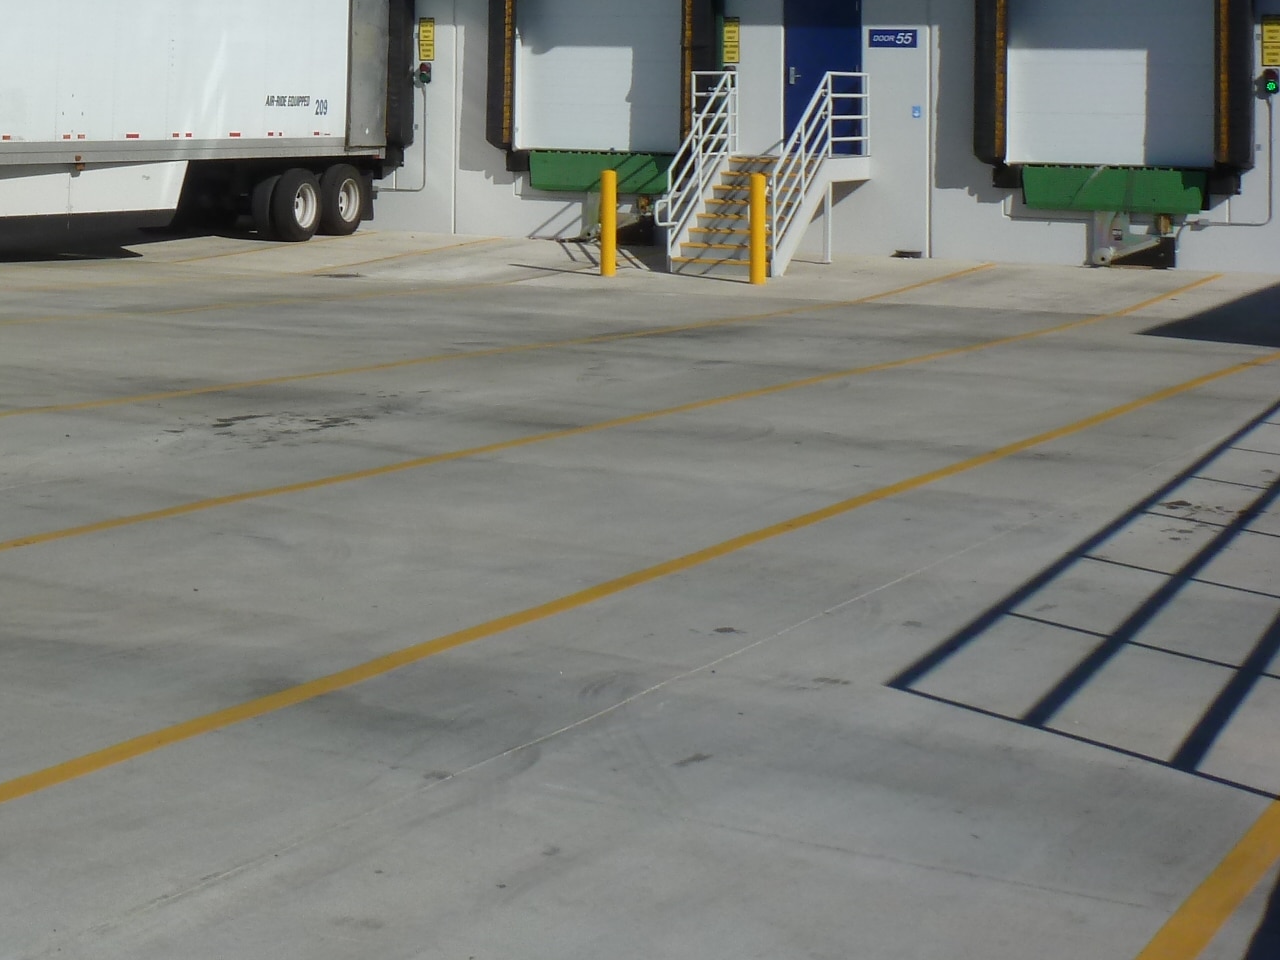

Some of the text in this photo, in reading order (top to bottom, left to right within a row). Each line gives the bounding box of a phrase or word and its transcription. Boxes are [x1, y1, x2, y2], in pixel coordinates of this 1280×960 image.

[872, 32, 913, 44] DOOR 55
[265, 95, 310, 107] AIR-RIDE EQUIPPED
[314, 99, 328, 115] 209
